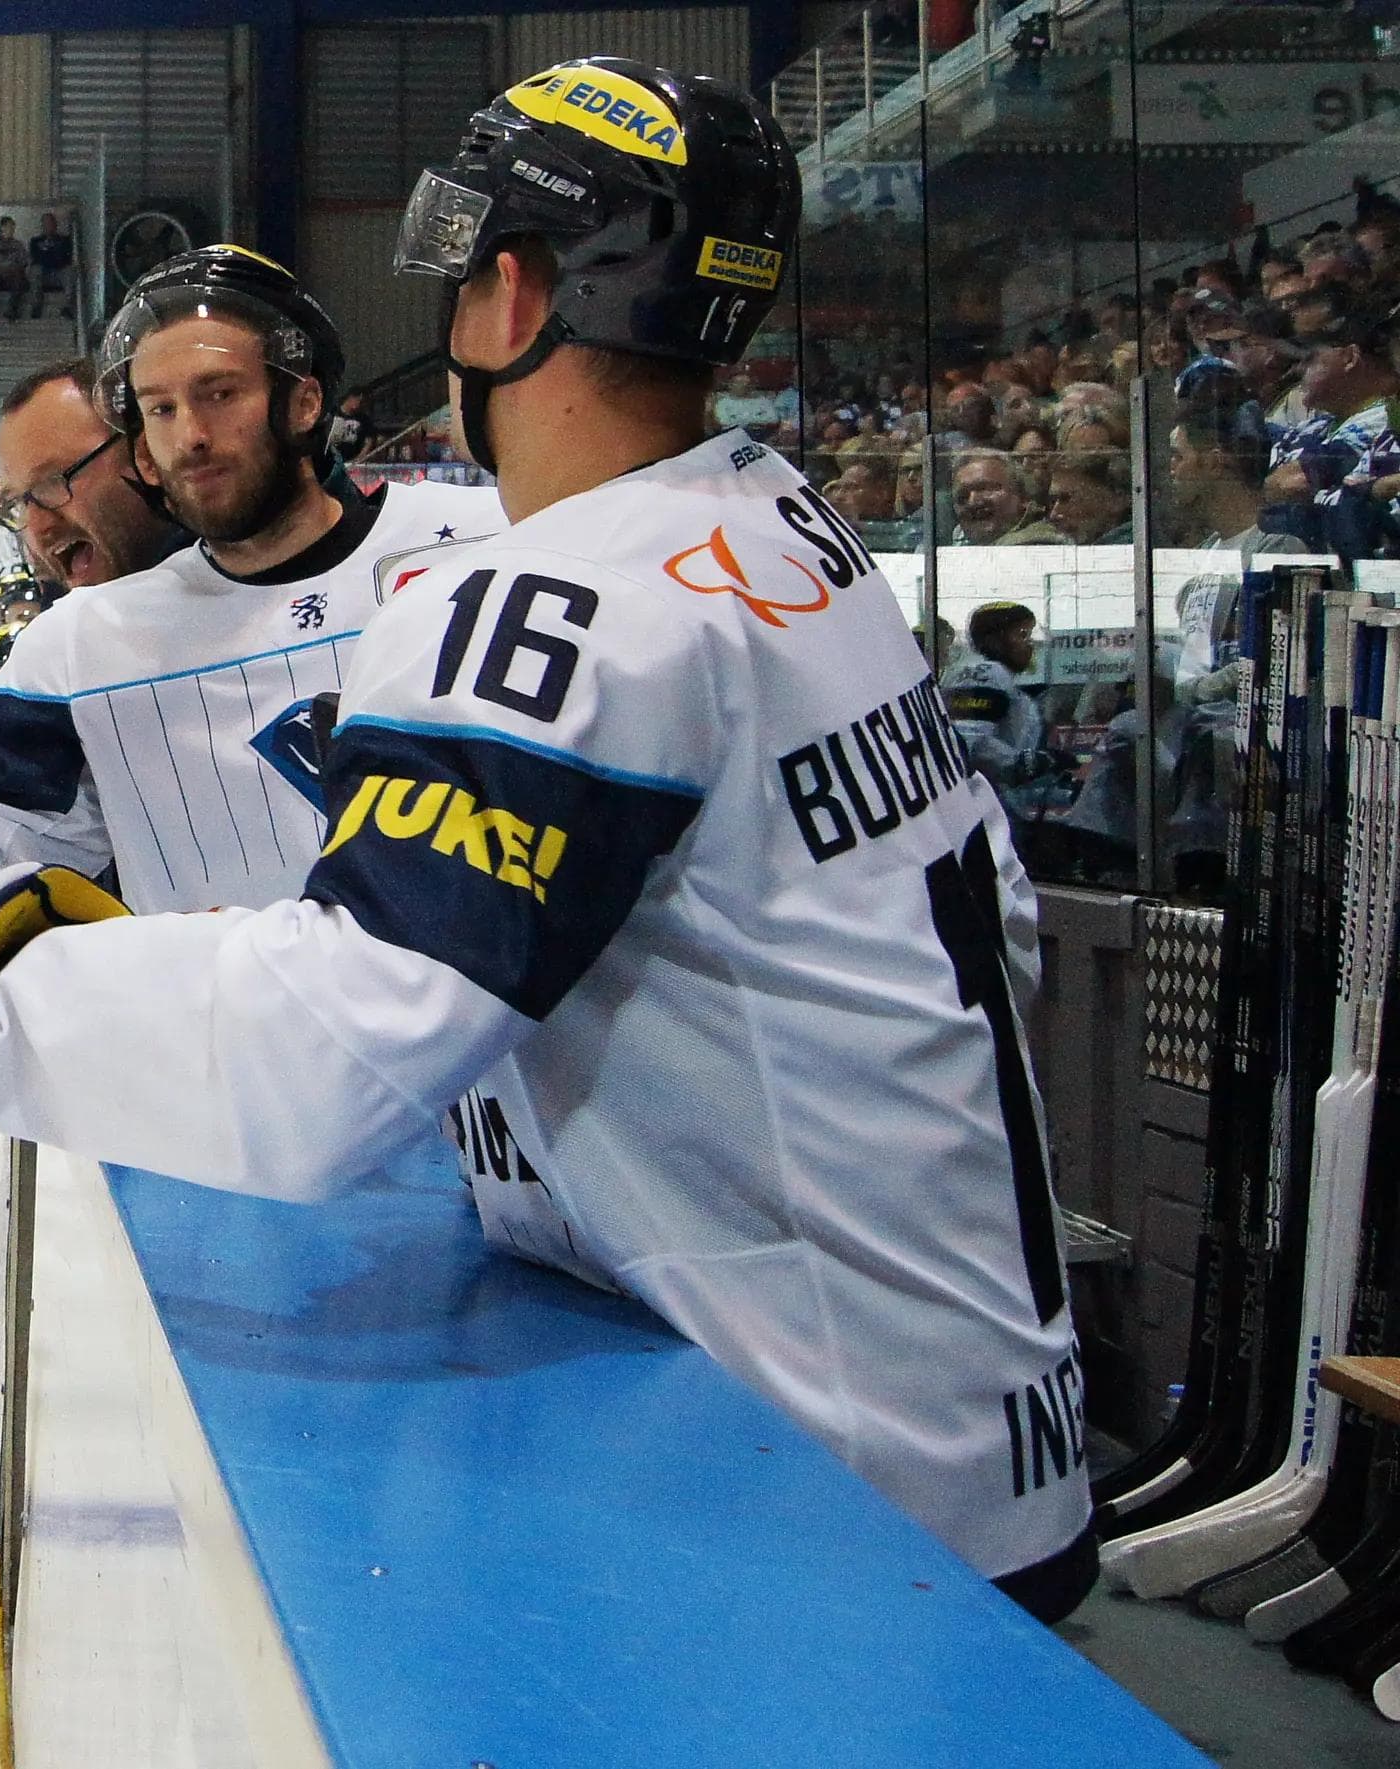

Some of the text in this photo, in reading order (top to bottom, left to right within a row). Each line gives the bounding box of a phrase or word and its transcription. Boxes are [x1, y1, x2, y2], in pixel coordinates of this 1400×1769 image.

[563, 82, 679, 156] EDEKA
[509, 158, 587, 203] BAUER
[710, 240, 781, 272] EDEKA
[431, 568, 599, 723] 16
[320, 774, 569, 904] JUKE!
